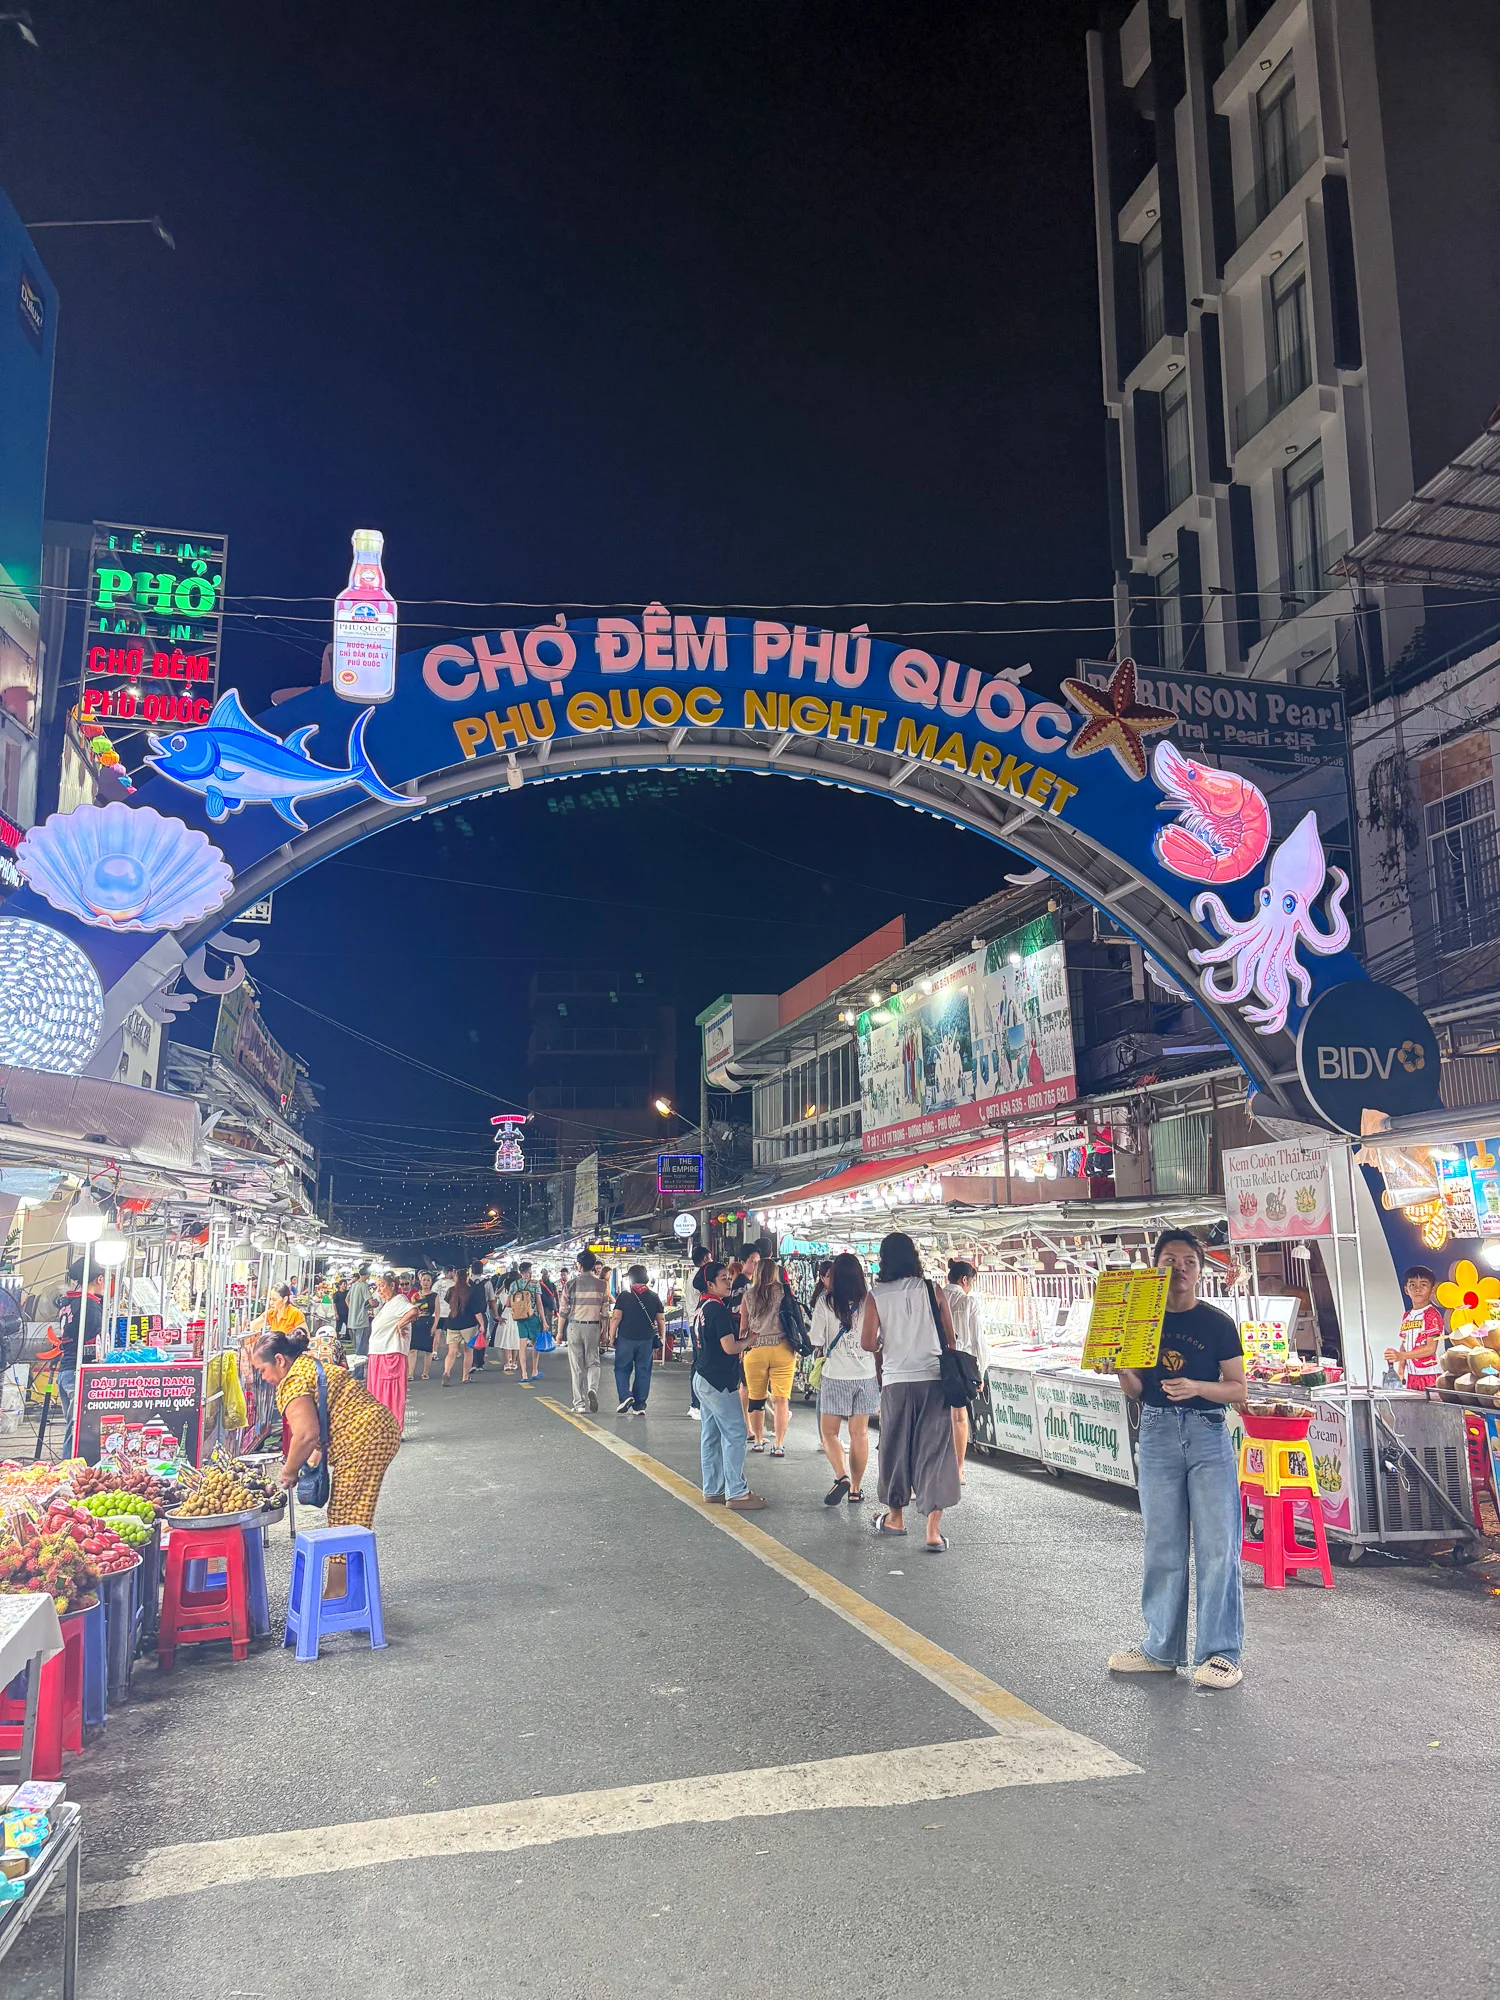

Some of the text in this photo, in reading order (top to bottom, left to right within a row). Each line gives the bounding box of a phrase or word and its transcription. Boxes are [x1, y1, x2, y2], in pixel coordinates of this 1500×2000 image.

[94, 559, 222, 617] PHỞ
[89, 646, 210, 683] CHỢ ĐÊM
[422, 600, 1073, 754] CHỢ ĐÊM PHÚ QUỐC
[142, 682, 211, 725] QUỐC
[1265, 694, 1344, 732] Pearl
[453, 686, 1079, 816] PHU QUOC NIGHT MARKET
[1224, 724, 1269, 745] Pearl
[1294, 753, 1321, 765] Since
[1317, 1046, 1397, 1080] BIDV
[985, 1104, 999, 1119] 0973
[1011, 1097, 1023, 1113] 535
[1027, 1092, 1043, 1109] 0978
[1043, 1089, 1056, 1106] 765
[1056, 1085, 1069, 1102] 621
[671, 1165, 699, 1173] EMPIRE
[1229, 1157, 1249, 1172] Kem
[1250, 1153, 1276, 1172] Cuộn
[1277, 1147, 1300, 1165] Thái
[1277, 1170, 1290, 1184] Ice
[90, 1377, 117, 1390] ĐẬU
[132, 1400, 143, 1409] 30
[1044, 1407, 1121, 1461] Anh Thượng
